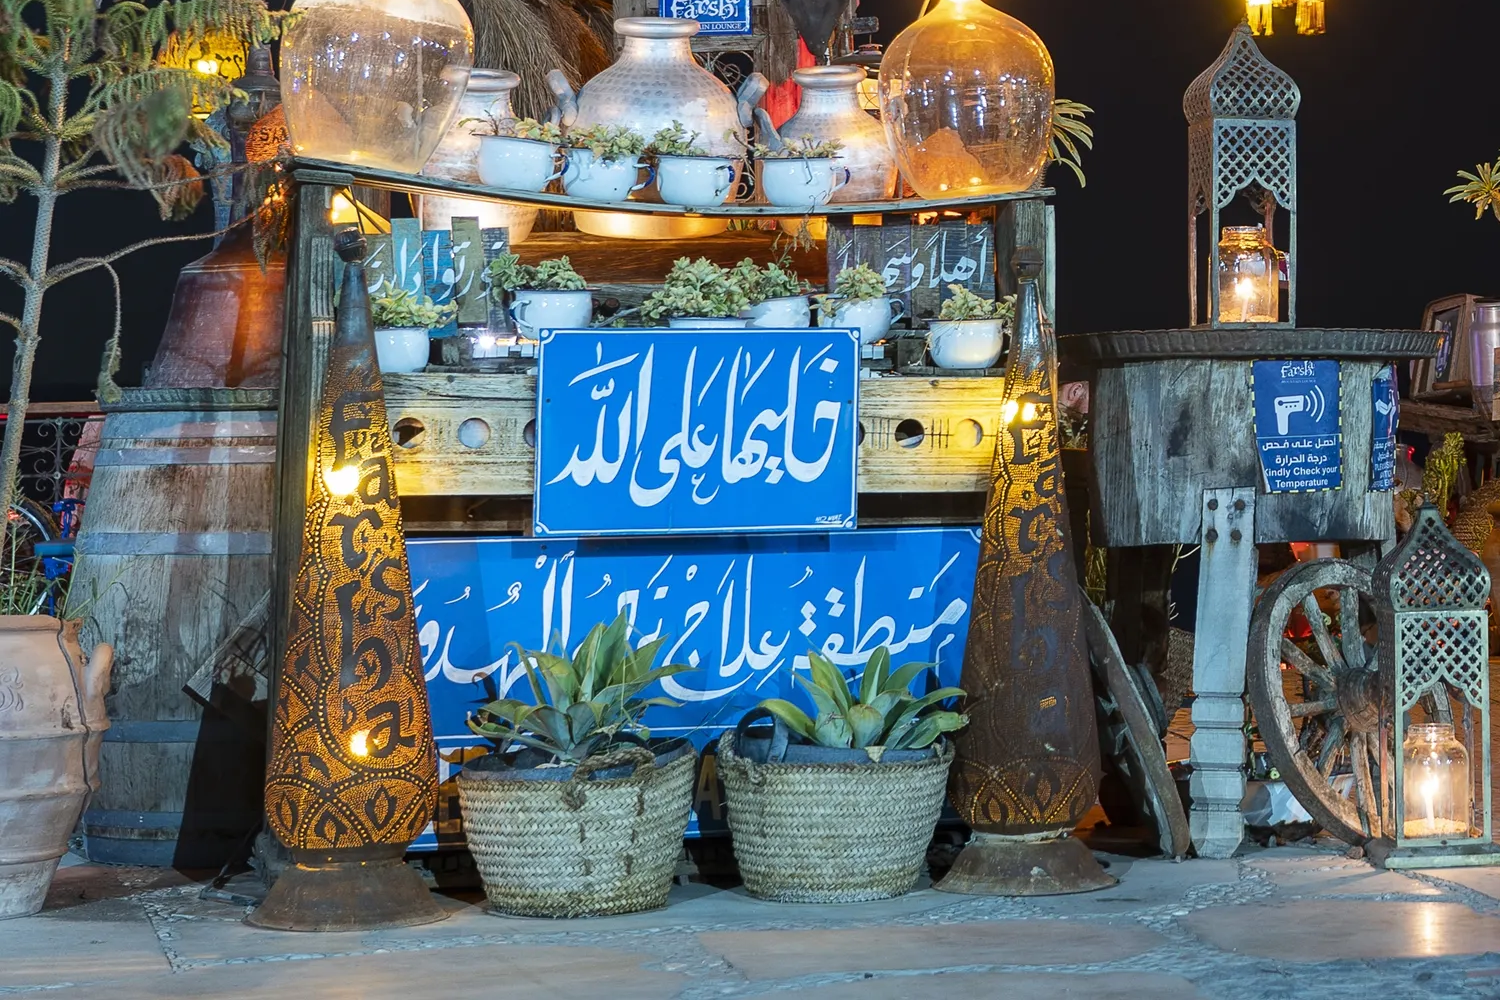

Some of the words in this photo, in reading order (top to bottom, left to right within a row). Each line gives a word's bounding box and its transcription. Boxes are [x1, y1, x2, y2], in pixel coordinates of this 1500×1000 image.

[1281, 360, 1316, 379] Farsha
[544, 340, 655, 488] الله
[722, 342, 842, 486] خليها
[629, 345, 725, 508] على
[1261, 440, 1290, 452] فحص
[1291, 438, 1314, 449] على
[1275, 453, 1305, 467] الحرارة
[1307, 453, 1328, 465] درجة
[1293, 466, 1321, 476] Check
[1322, 465, 1338, 477] your
[1275, 478, 1329, 489] Temperature
[660, 554, 792, 702] علاج
